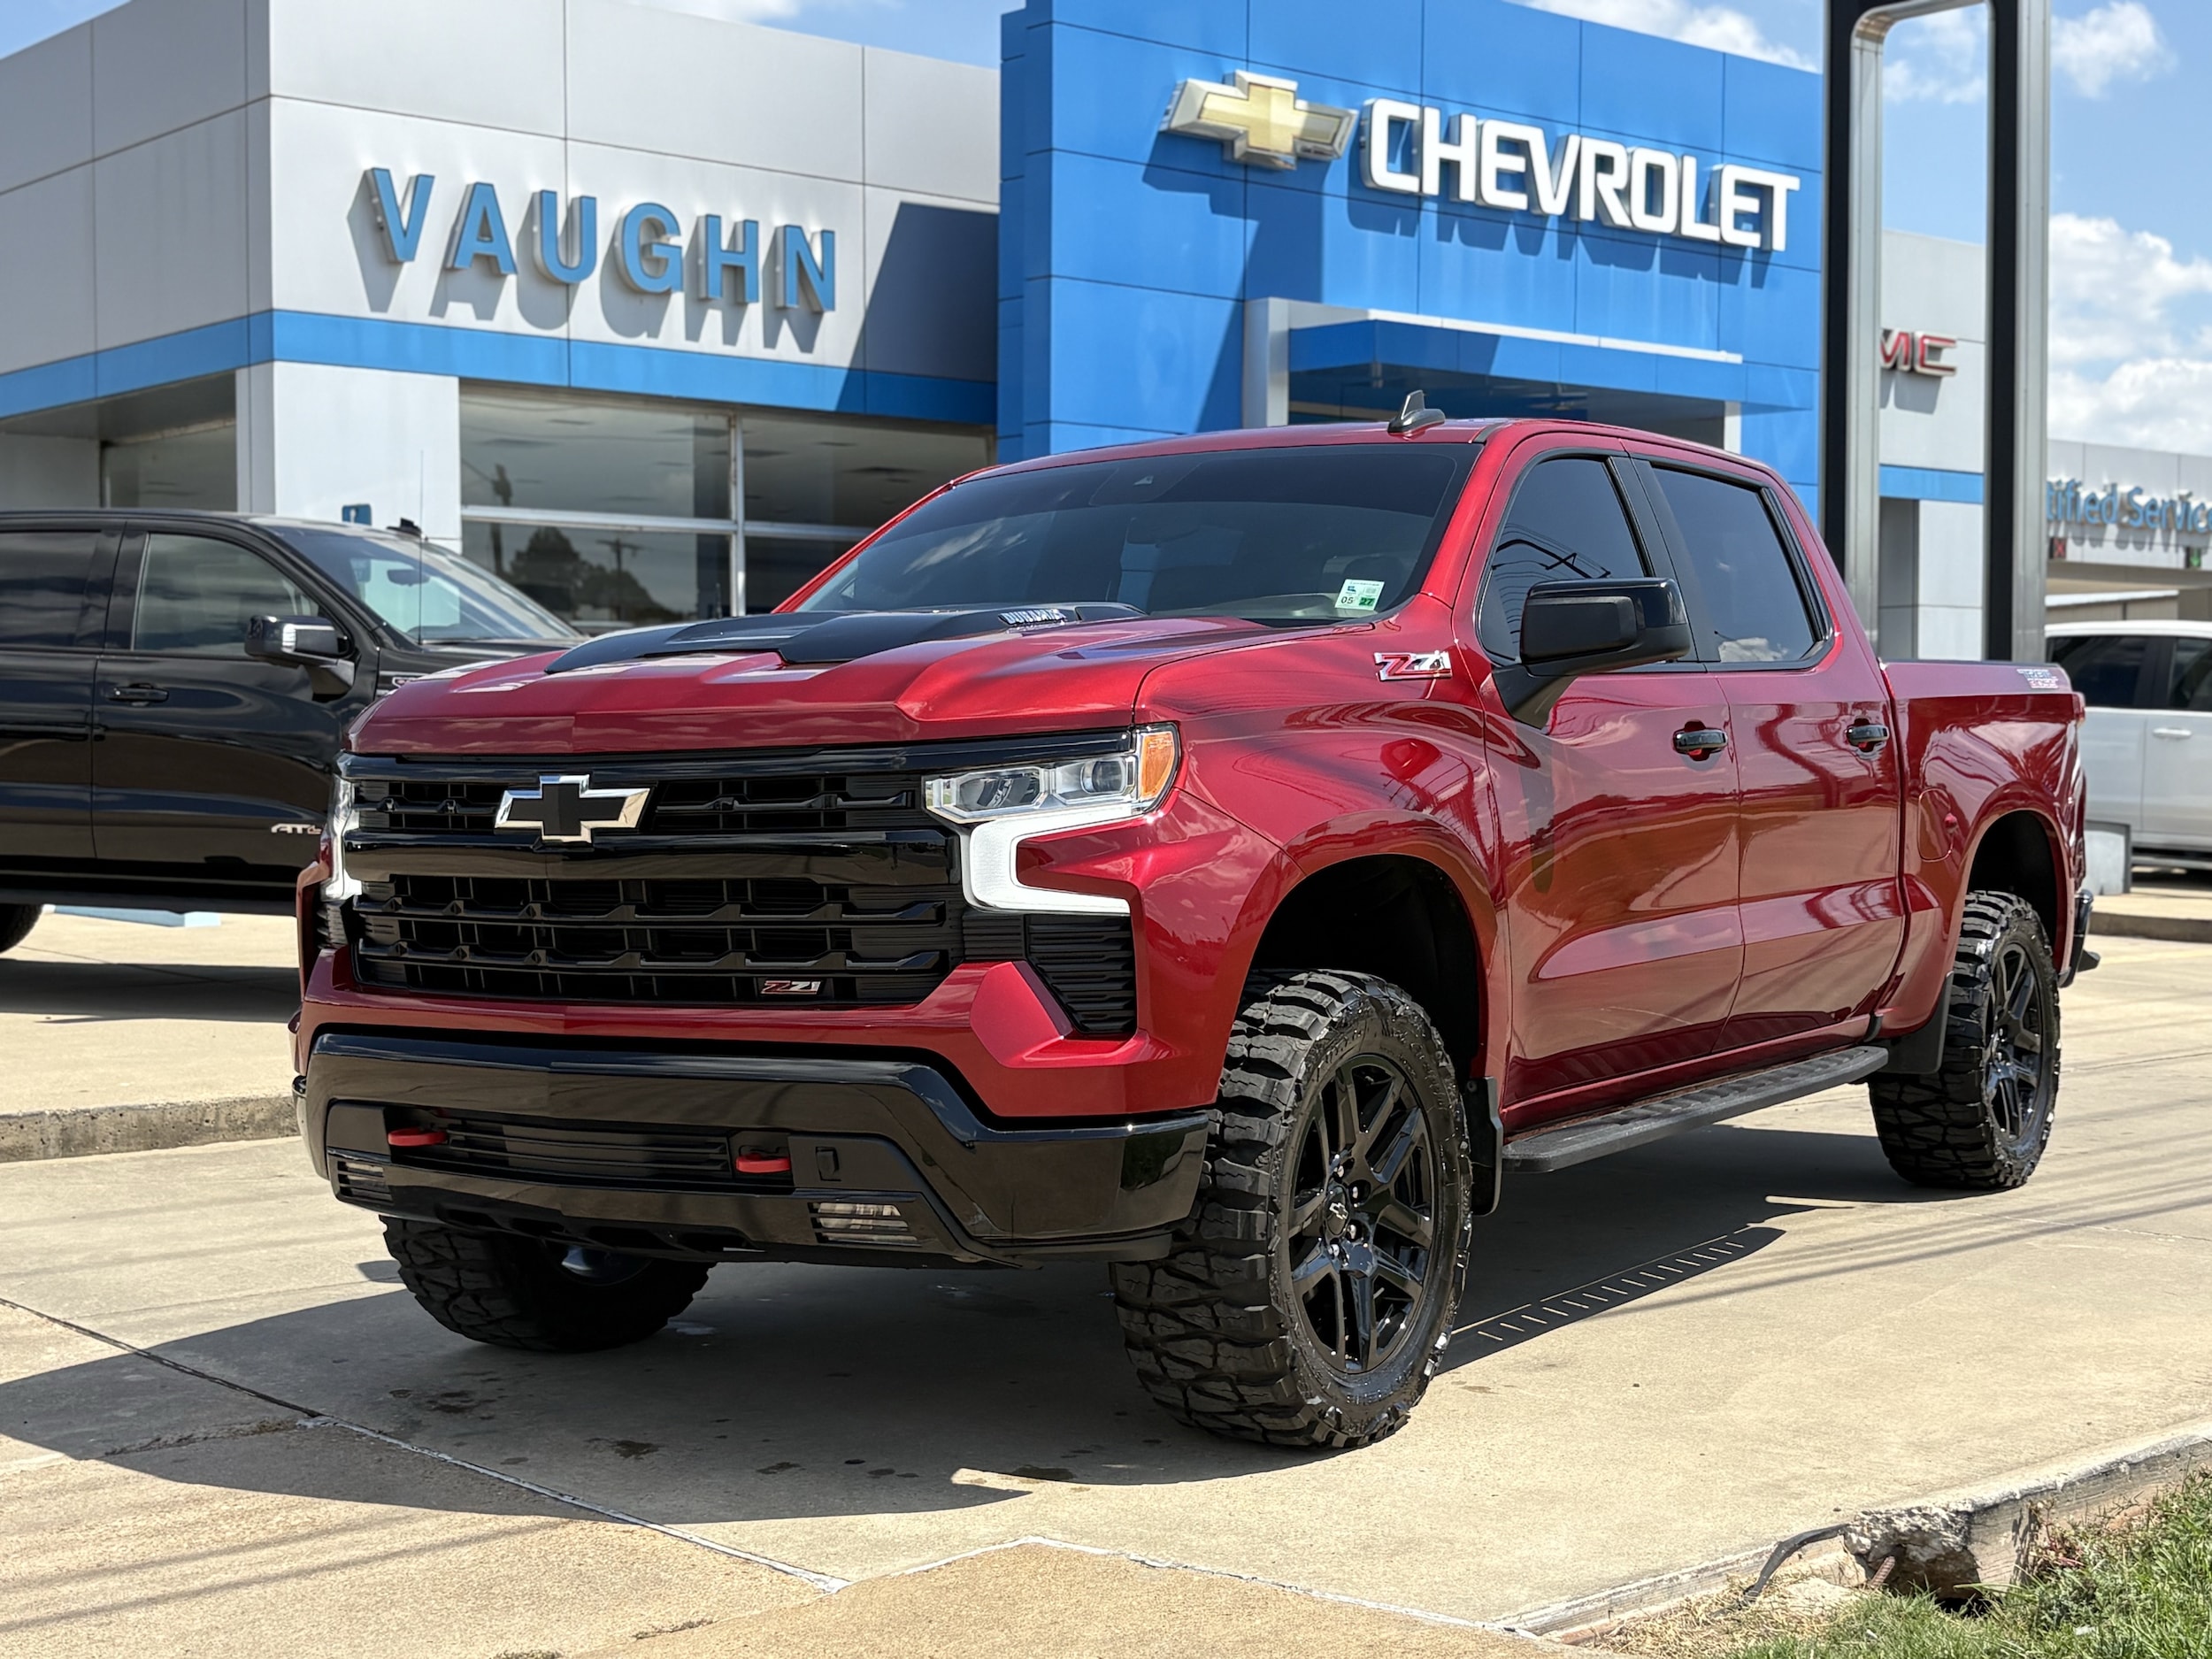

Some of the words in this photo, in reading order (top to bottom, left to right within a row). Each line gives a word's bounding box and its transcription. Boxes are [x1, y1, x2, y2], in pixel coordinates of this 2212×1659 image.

[1363, 97, 1801, 253] CHEVROLET
[365, 167, 836, 312] VAUGHN
[1880, 330, 1956, 376] MC
[2047, 479, 2118, 525] tified
[1340, 595, 1354, 604] 05
[1359, 596, 1375, 606] 27
[1374, 649, 1452, 680] Z71
[761, 979, 821, 995] Z71
